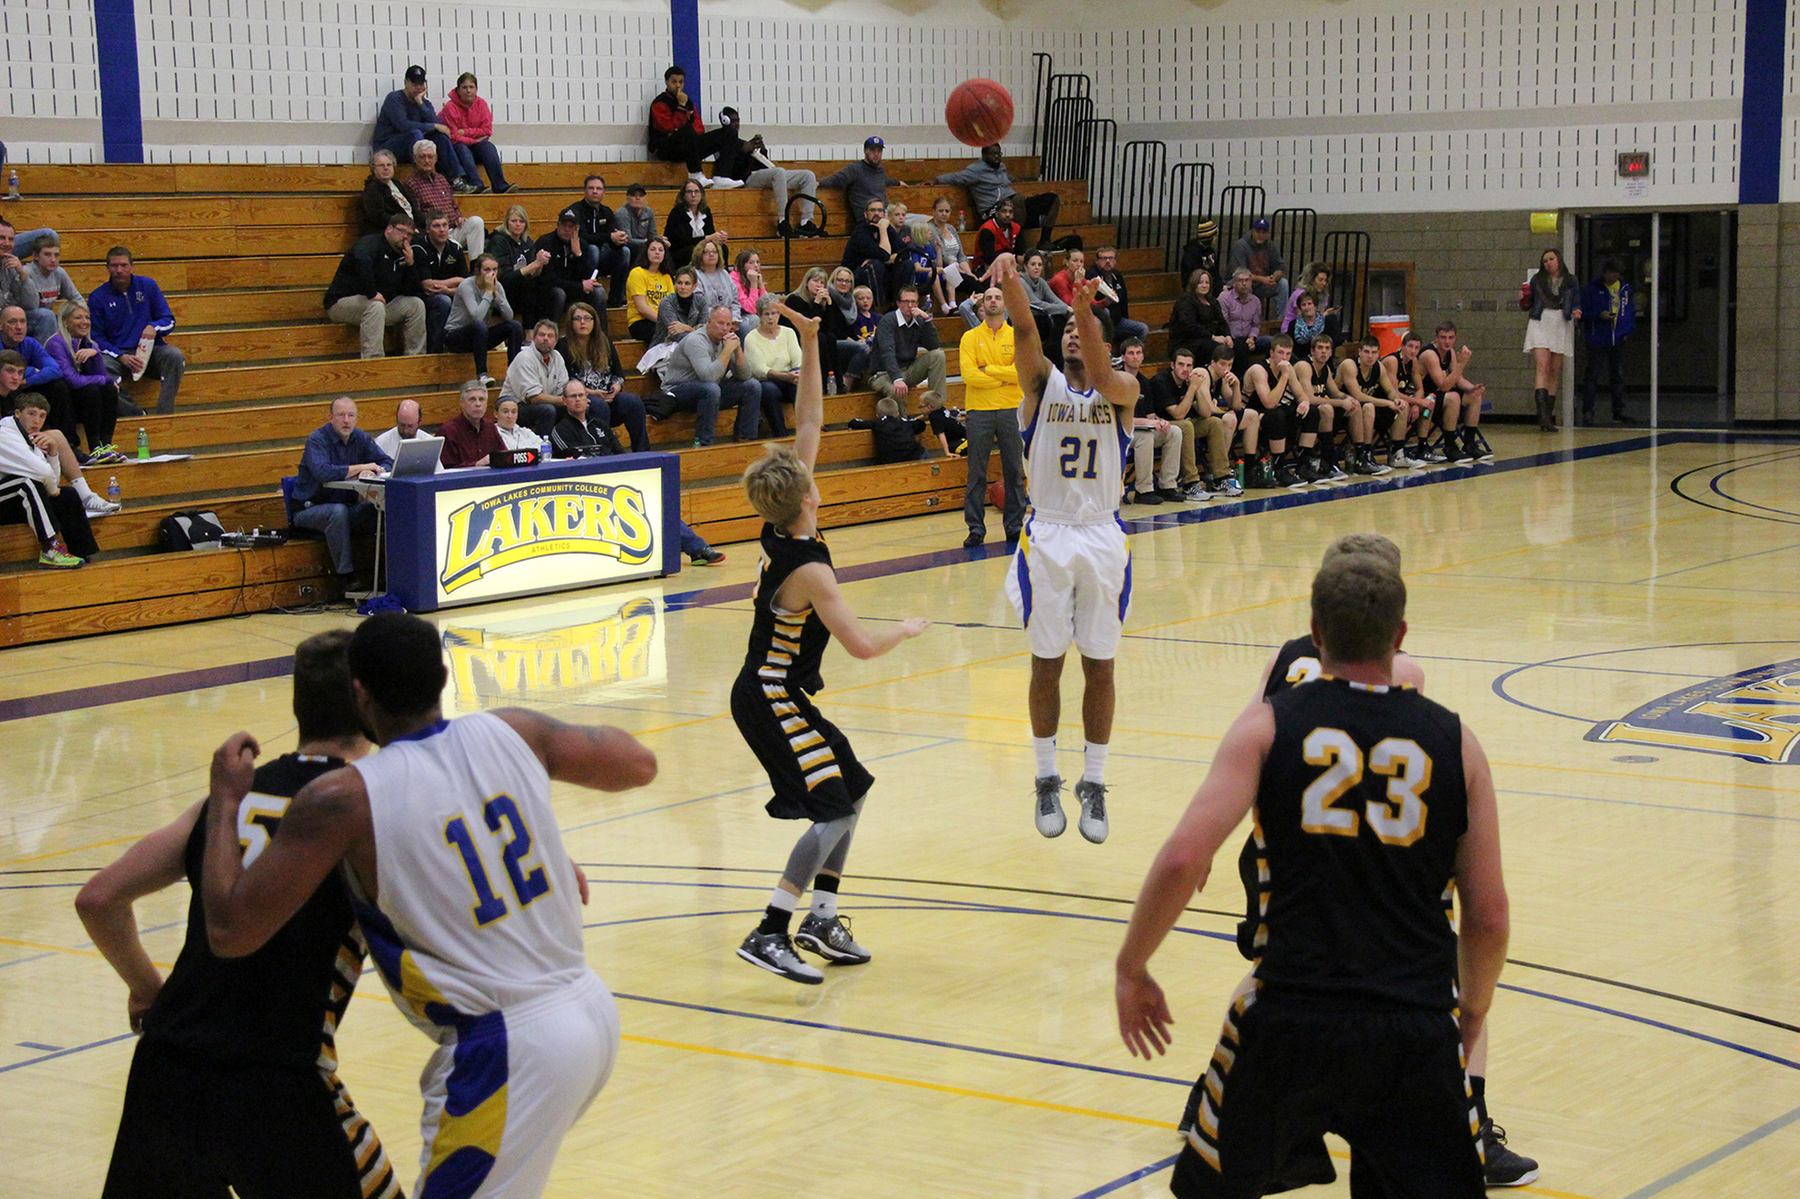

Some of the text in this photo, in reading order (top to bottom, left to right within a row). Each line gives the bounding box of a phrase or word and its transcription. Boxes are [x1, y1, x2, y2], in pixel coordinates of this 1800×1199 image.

[1046, 403, 1075, 423] IOWA
[513, 452, 528, 464] POSS
[1060, 435, 1098, 480] 21
[481, 484, 608, 511] IOWA LAKES COMMUNITY COLLEGE
[443, 486, 652, 581] LAKERS
[531, 542, 571, 554] ATHLETICS
[1301, 726, 1433, 847] 23
[442, 791, 553, 930] 12
